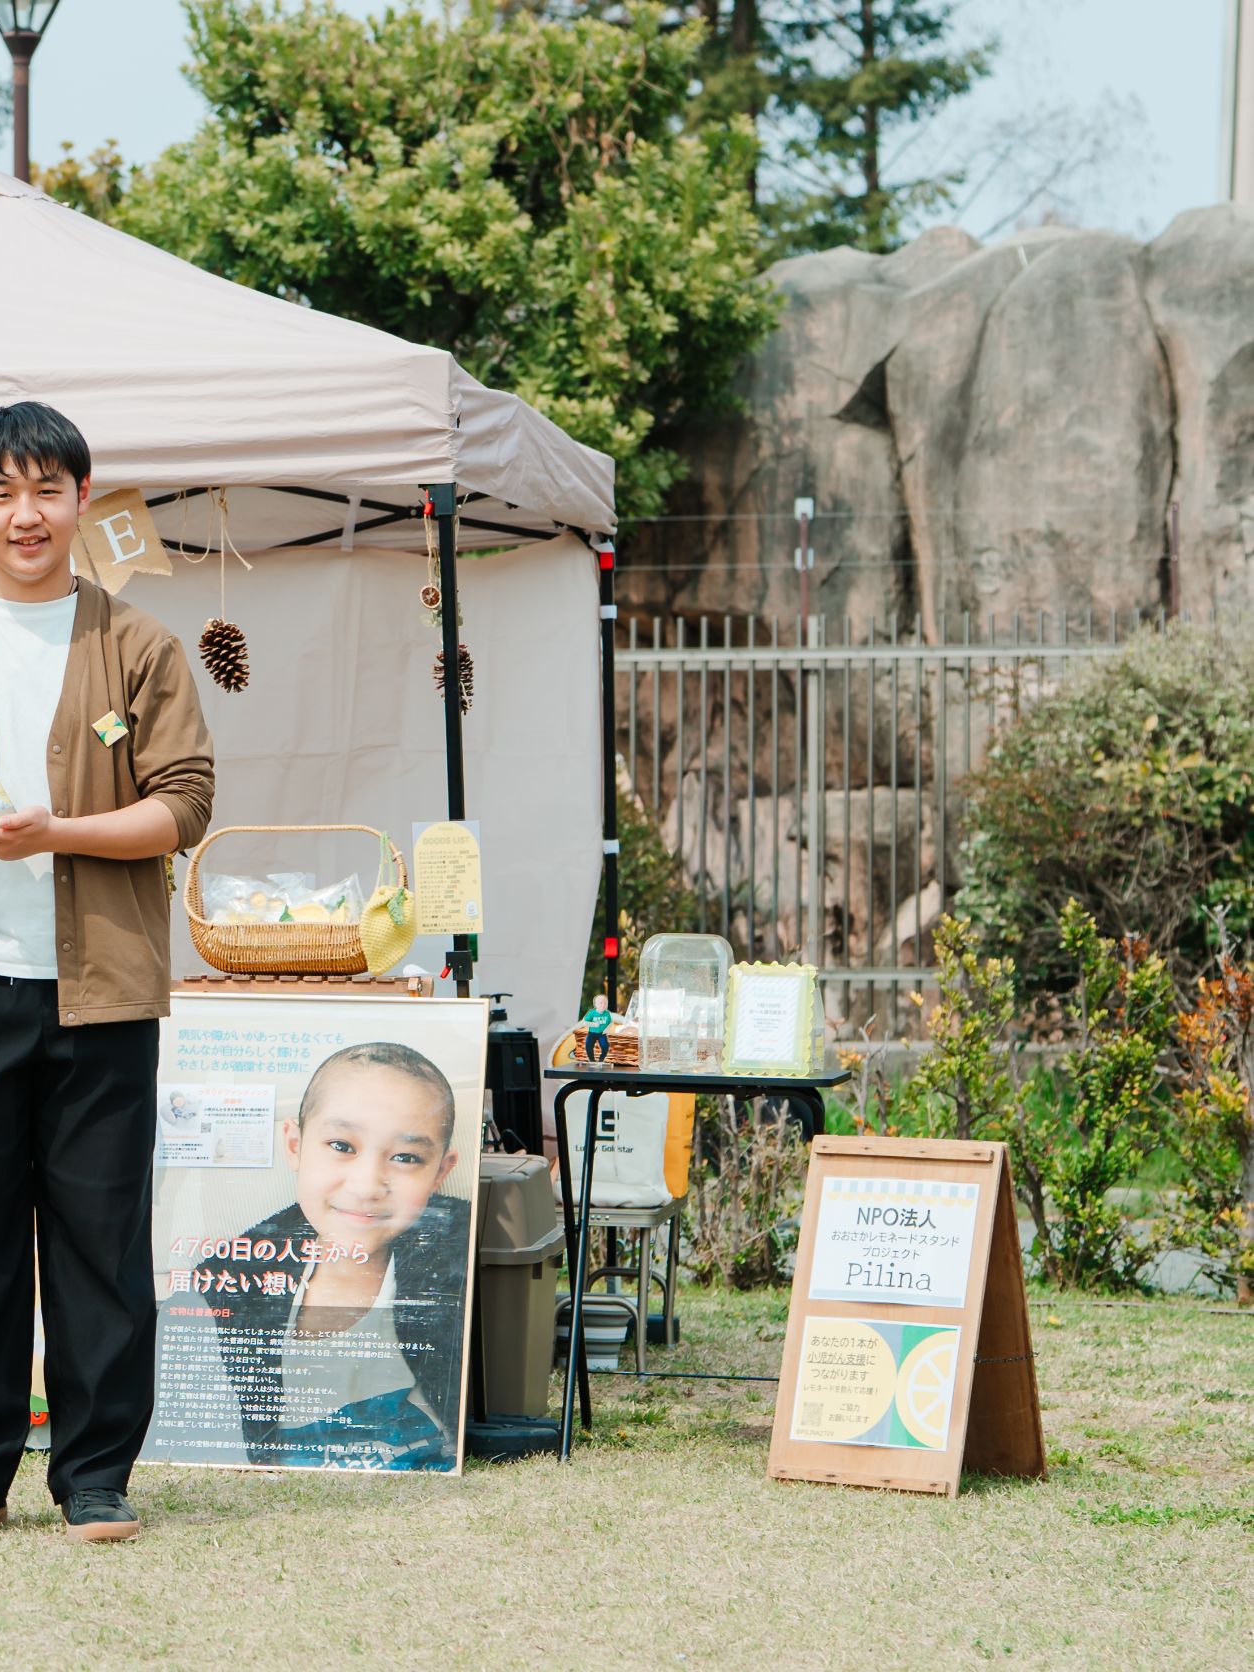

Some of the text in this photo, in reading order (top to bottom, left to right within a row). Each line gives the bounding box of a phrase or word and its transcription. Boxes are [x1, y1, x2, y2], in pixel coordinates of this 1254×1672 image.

[575, 1144, 634, 1154] Luy Golstar
[856, 1206, 936, 1230] NPO法人
[831, 1229, 960, 1247] おおさかレモネードスタンド
[169, 1236, 370, 1266] 4760日の人生から
[861, 1247, 921, 1261] プロジェクト
[168, 1267, 311, 1297] 届けたい想い
[845, 1261, 932, 1292] Pilina
[810, 1335, 878, 1350] あなたの1本が
[807, 1351, 876, 1366] 小児がん支援に
[811, 1368, 870, 1382] つながります
